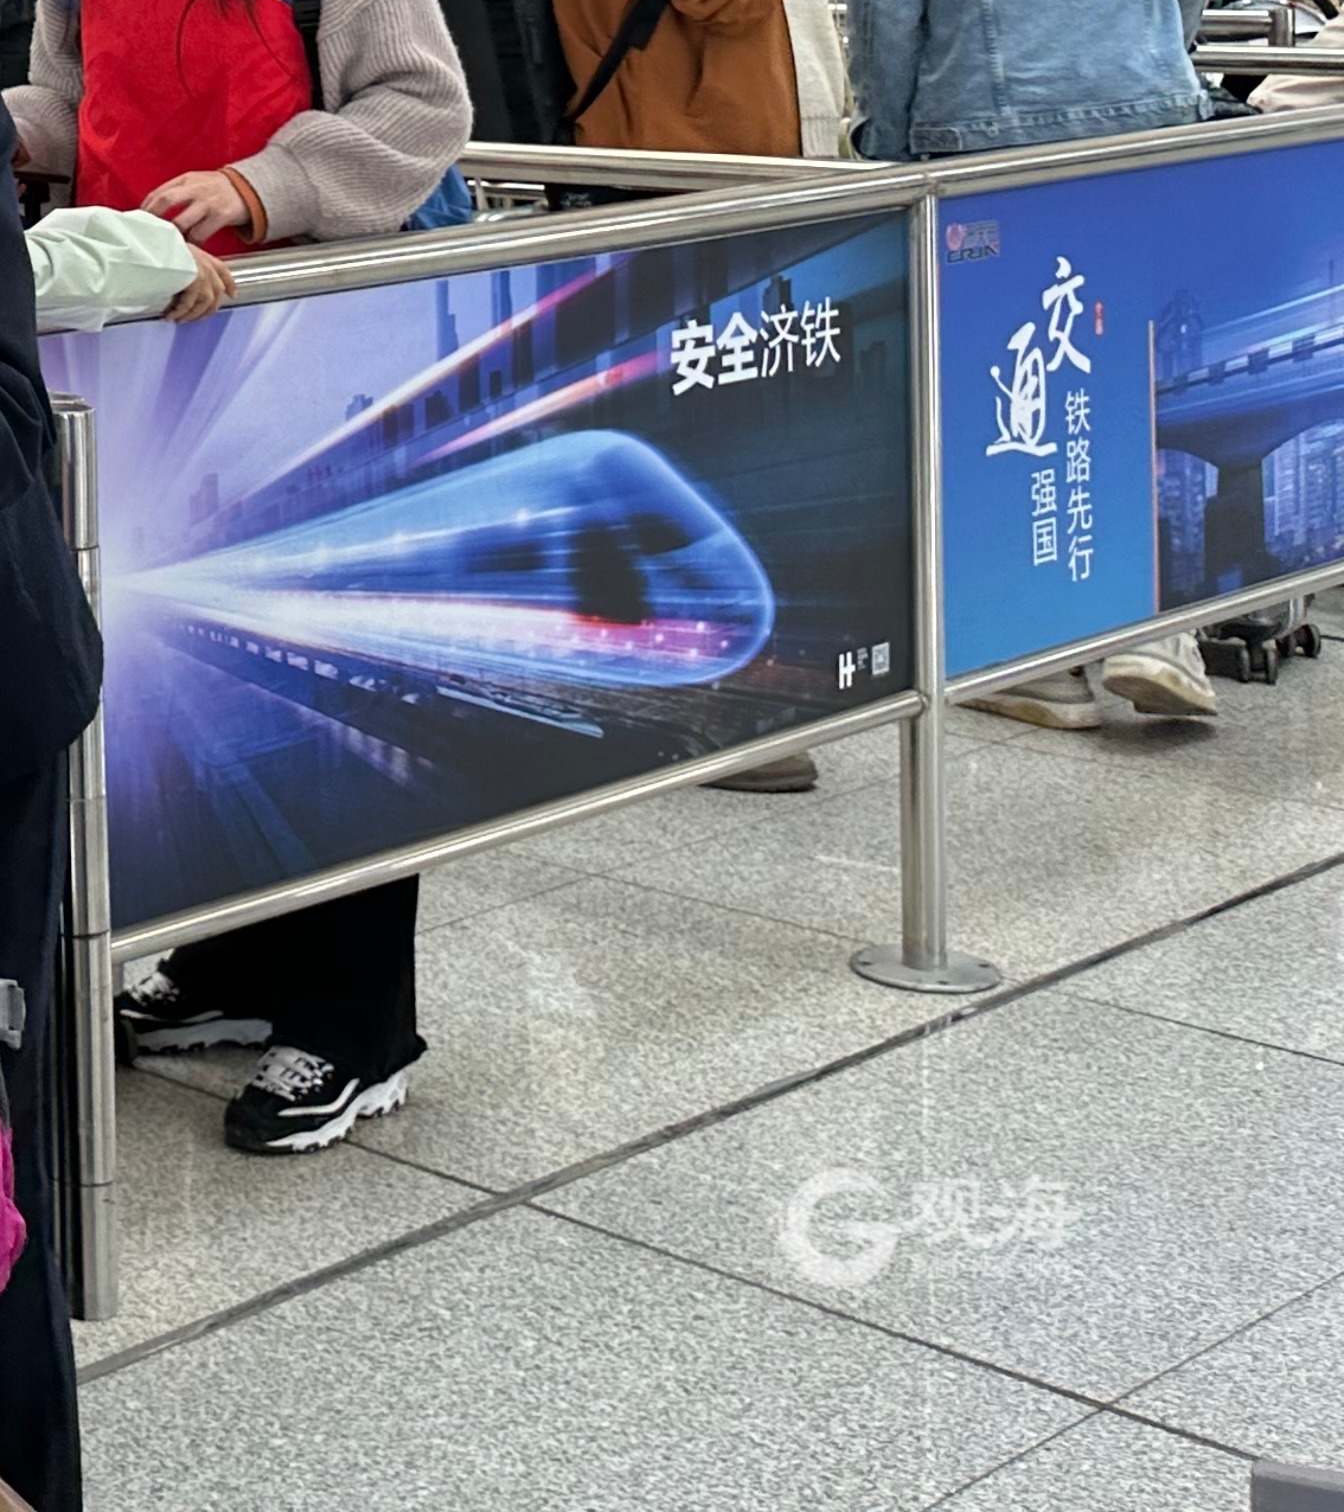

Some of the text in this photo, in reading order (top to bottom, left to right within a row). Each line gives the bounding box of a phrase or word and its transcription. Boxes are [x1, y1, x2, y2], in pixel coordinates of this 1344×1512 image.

[669, 296, 842, 396] 安全济铁
[1030, 470, 1058, 567] 强国
[1064, 389, 1095, 583] 铁路先行
